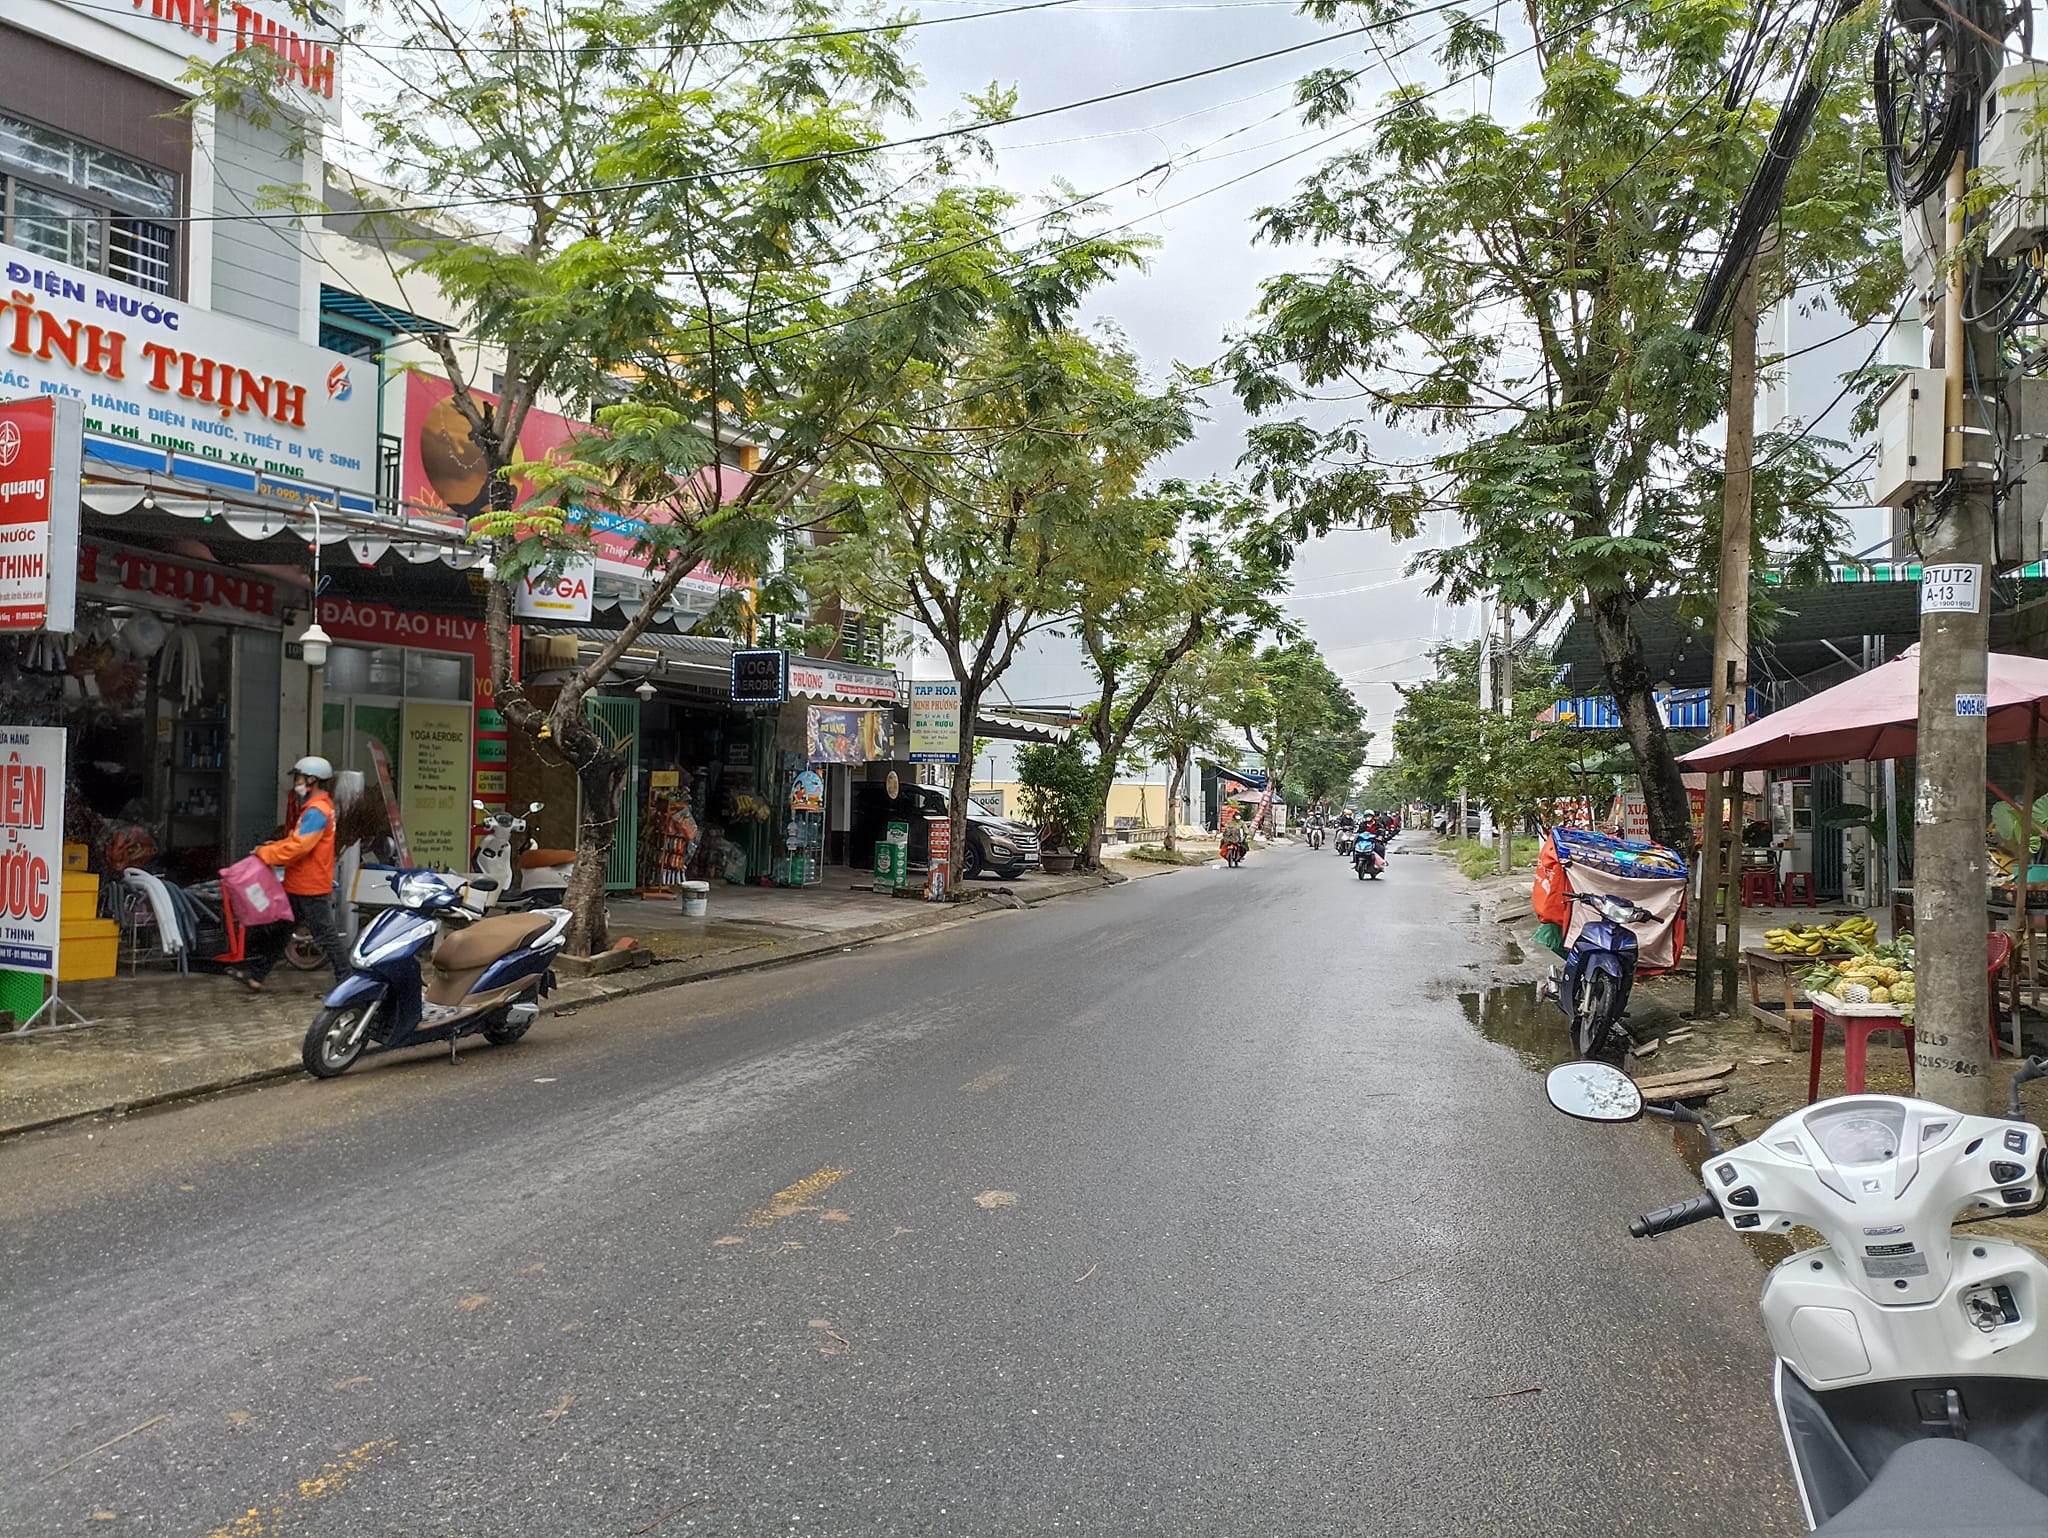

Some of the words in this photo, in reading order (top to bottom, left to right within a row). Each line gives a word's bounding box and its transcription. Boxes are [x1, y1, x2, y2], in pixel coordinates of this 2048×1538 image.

[6, 261, 86, 303] ĐIỆN
[96, 288, 179, 331] NƯỚC
[143, 341, 307, 429] THỊNH
[91, 393, 140, 416] HÀNG
[148, 406, 185, 428] ĐIỆN
[244, 431, 282, 451] THIẾT
[329, 453, 361, 471] SINH
[1, 479, 45, 503] quang
[1, 528, 35, 543] NƯỚC
[117, 553, 276, 617] THỊNH
[524, 575, 588, 600] YGA
[1926, 585, 1954, 601] A-13
[322, 599, 376, 627] ĐÀO
[381, 610, 429, 636] TẠO
[436, 617, 477, 640] HLV
[739, 660, 776, 675] YOGA
[410, 730, 430, 740] YOGA
[5, 928, 35, 943] THỊNH
